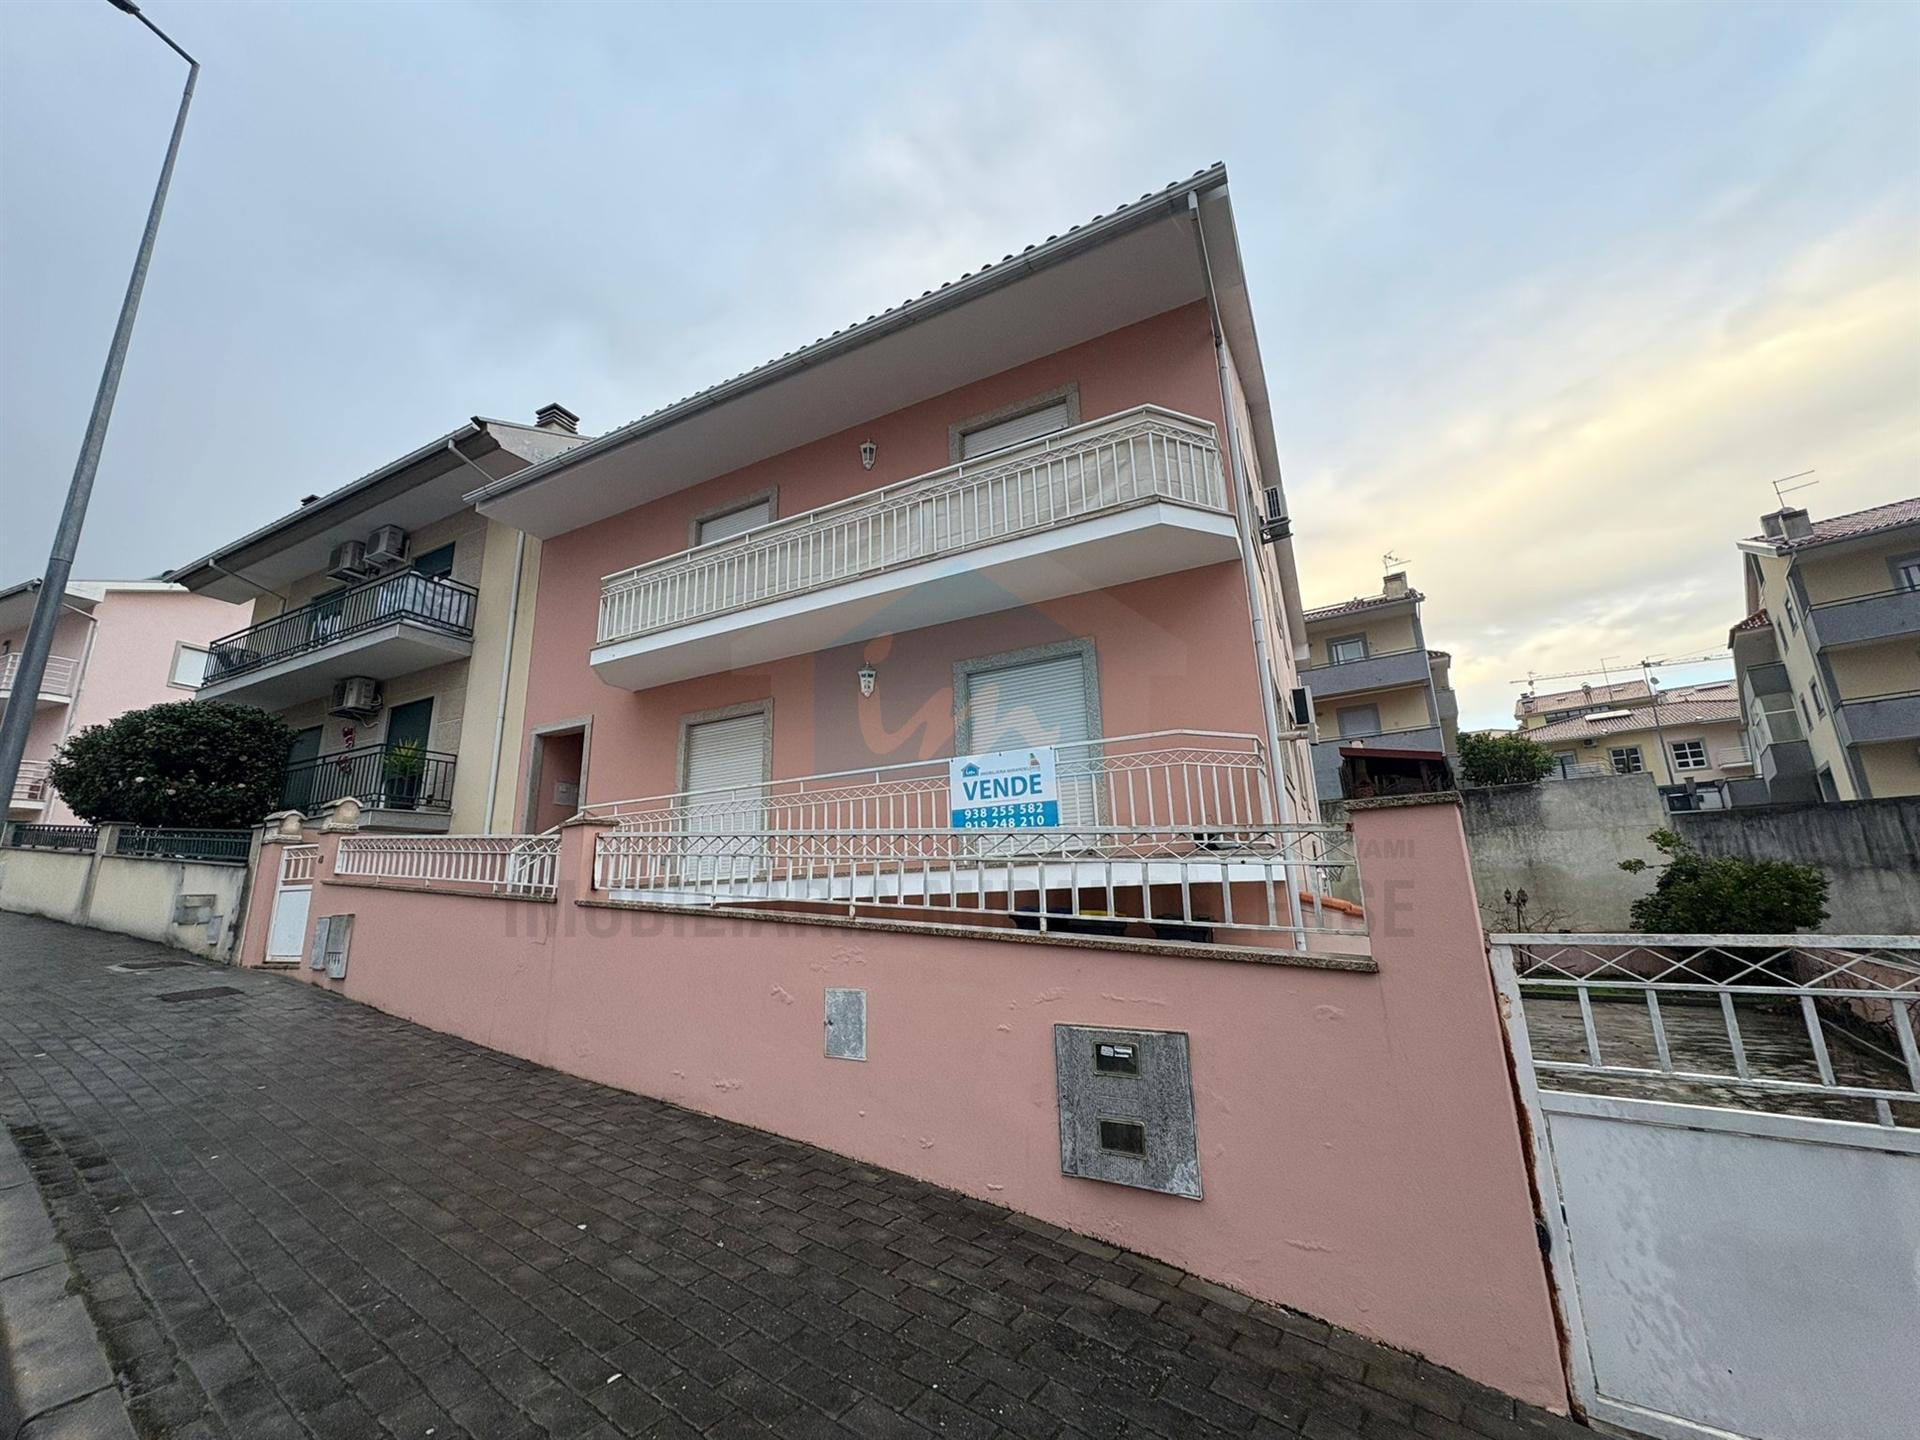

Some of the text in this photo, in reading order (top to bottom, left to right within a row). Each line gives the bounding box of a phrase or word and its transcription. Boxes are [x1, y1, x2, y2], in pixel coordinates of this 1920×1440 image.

[962, 773, 1043, 801] VENDE
[964, 802, 1044, 820] 938 255 582
[965, 815, 1045, 829] 919 248 210
